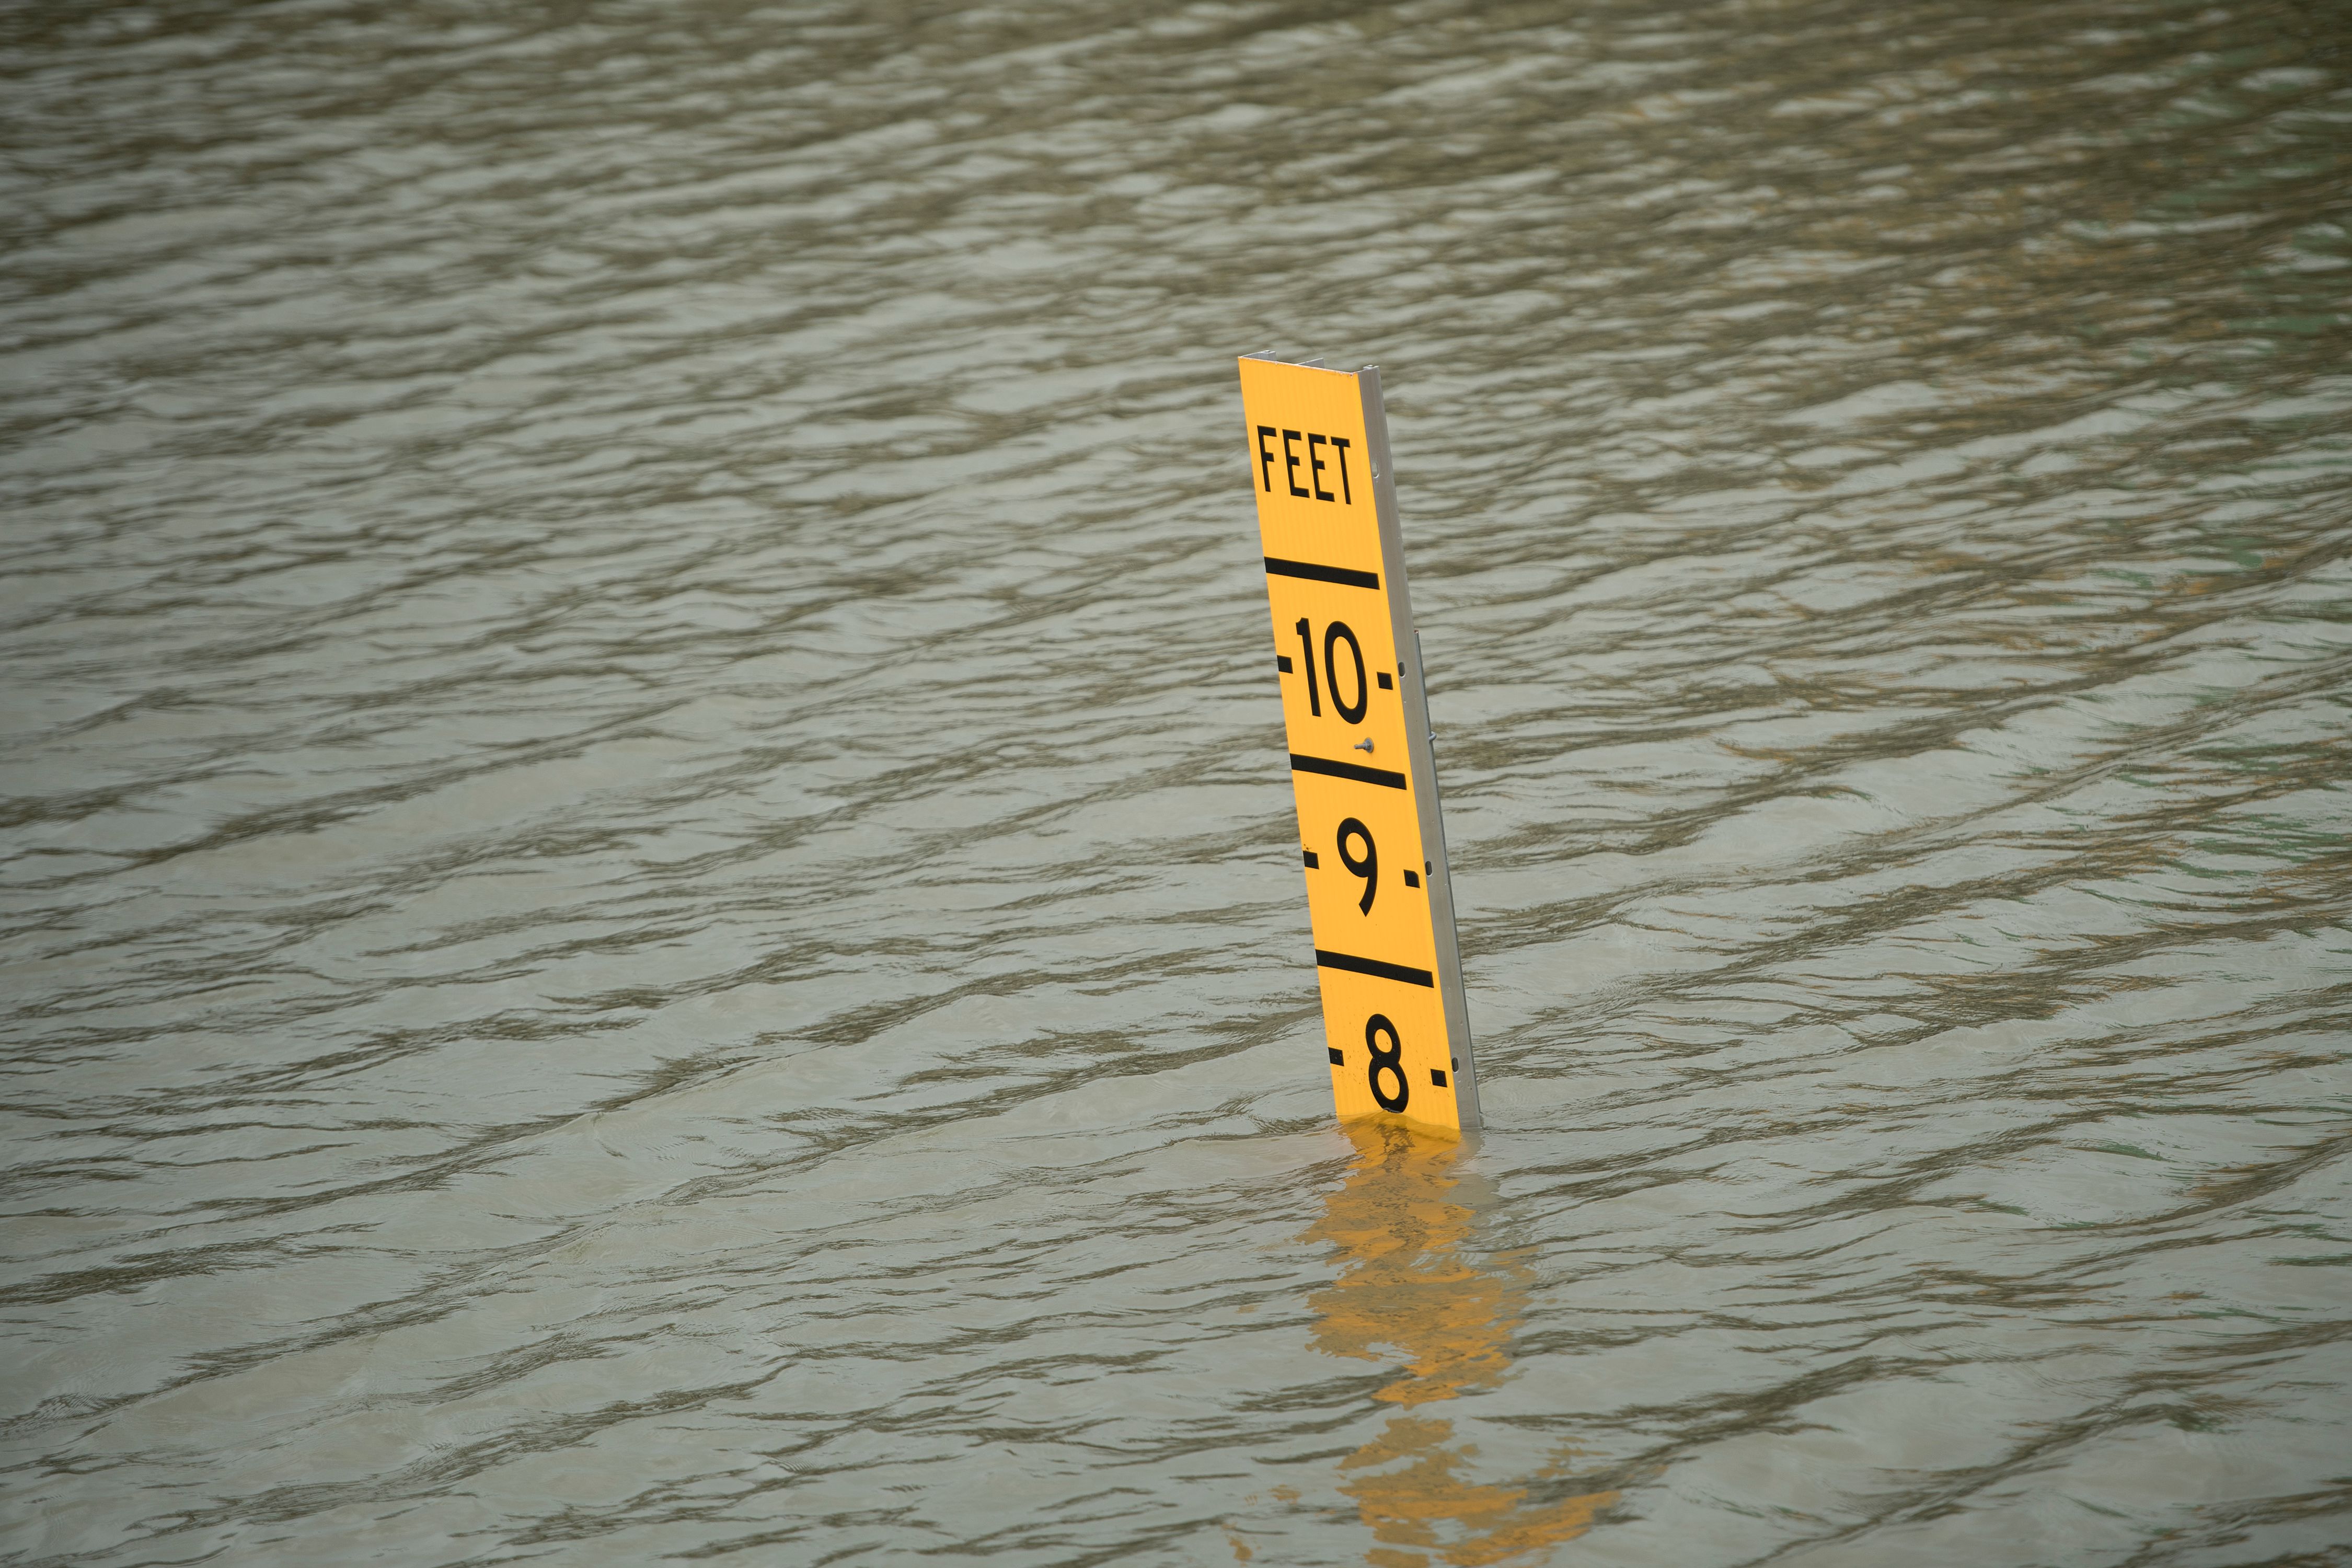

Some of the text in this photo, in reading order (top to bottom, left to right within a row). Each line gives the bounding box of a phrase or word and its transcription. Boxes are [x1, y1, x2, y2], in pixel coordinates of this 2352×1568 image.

[1257, 425, 1352, 505] FEET
[1296, 618, 1367, 724] 10
[1336, 817, 1378, 917] 9
[1365, 1013, 1409, 1114] 8
